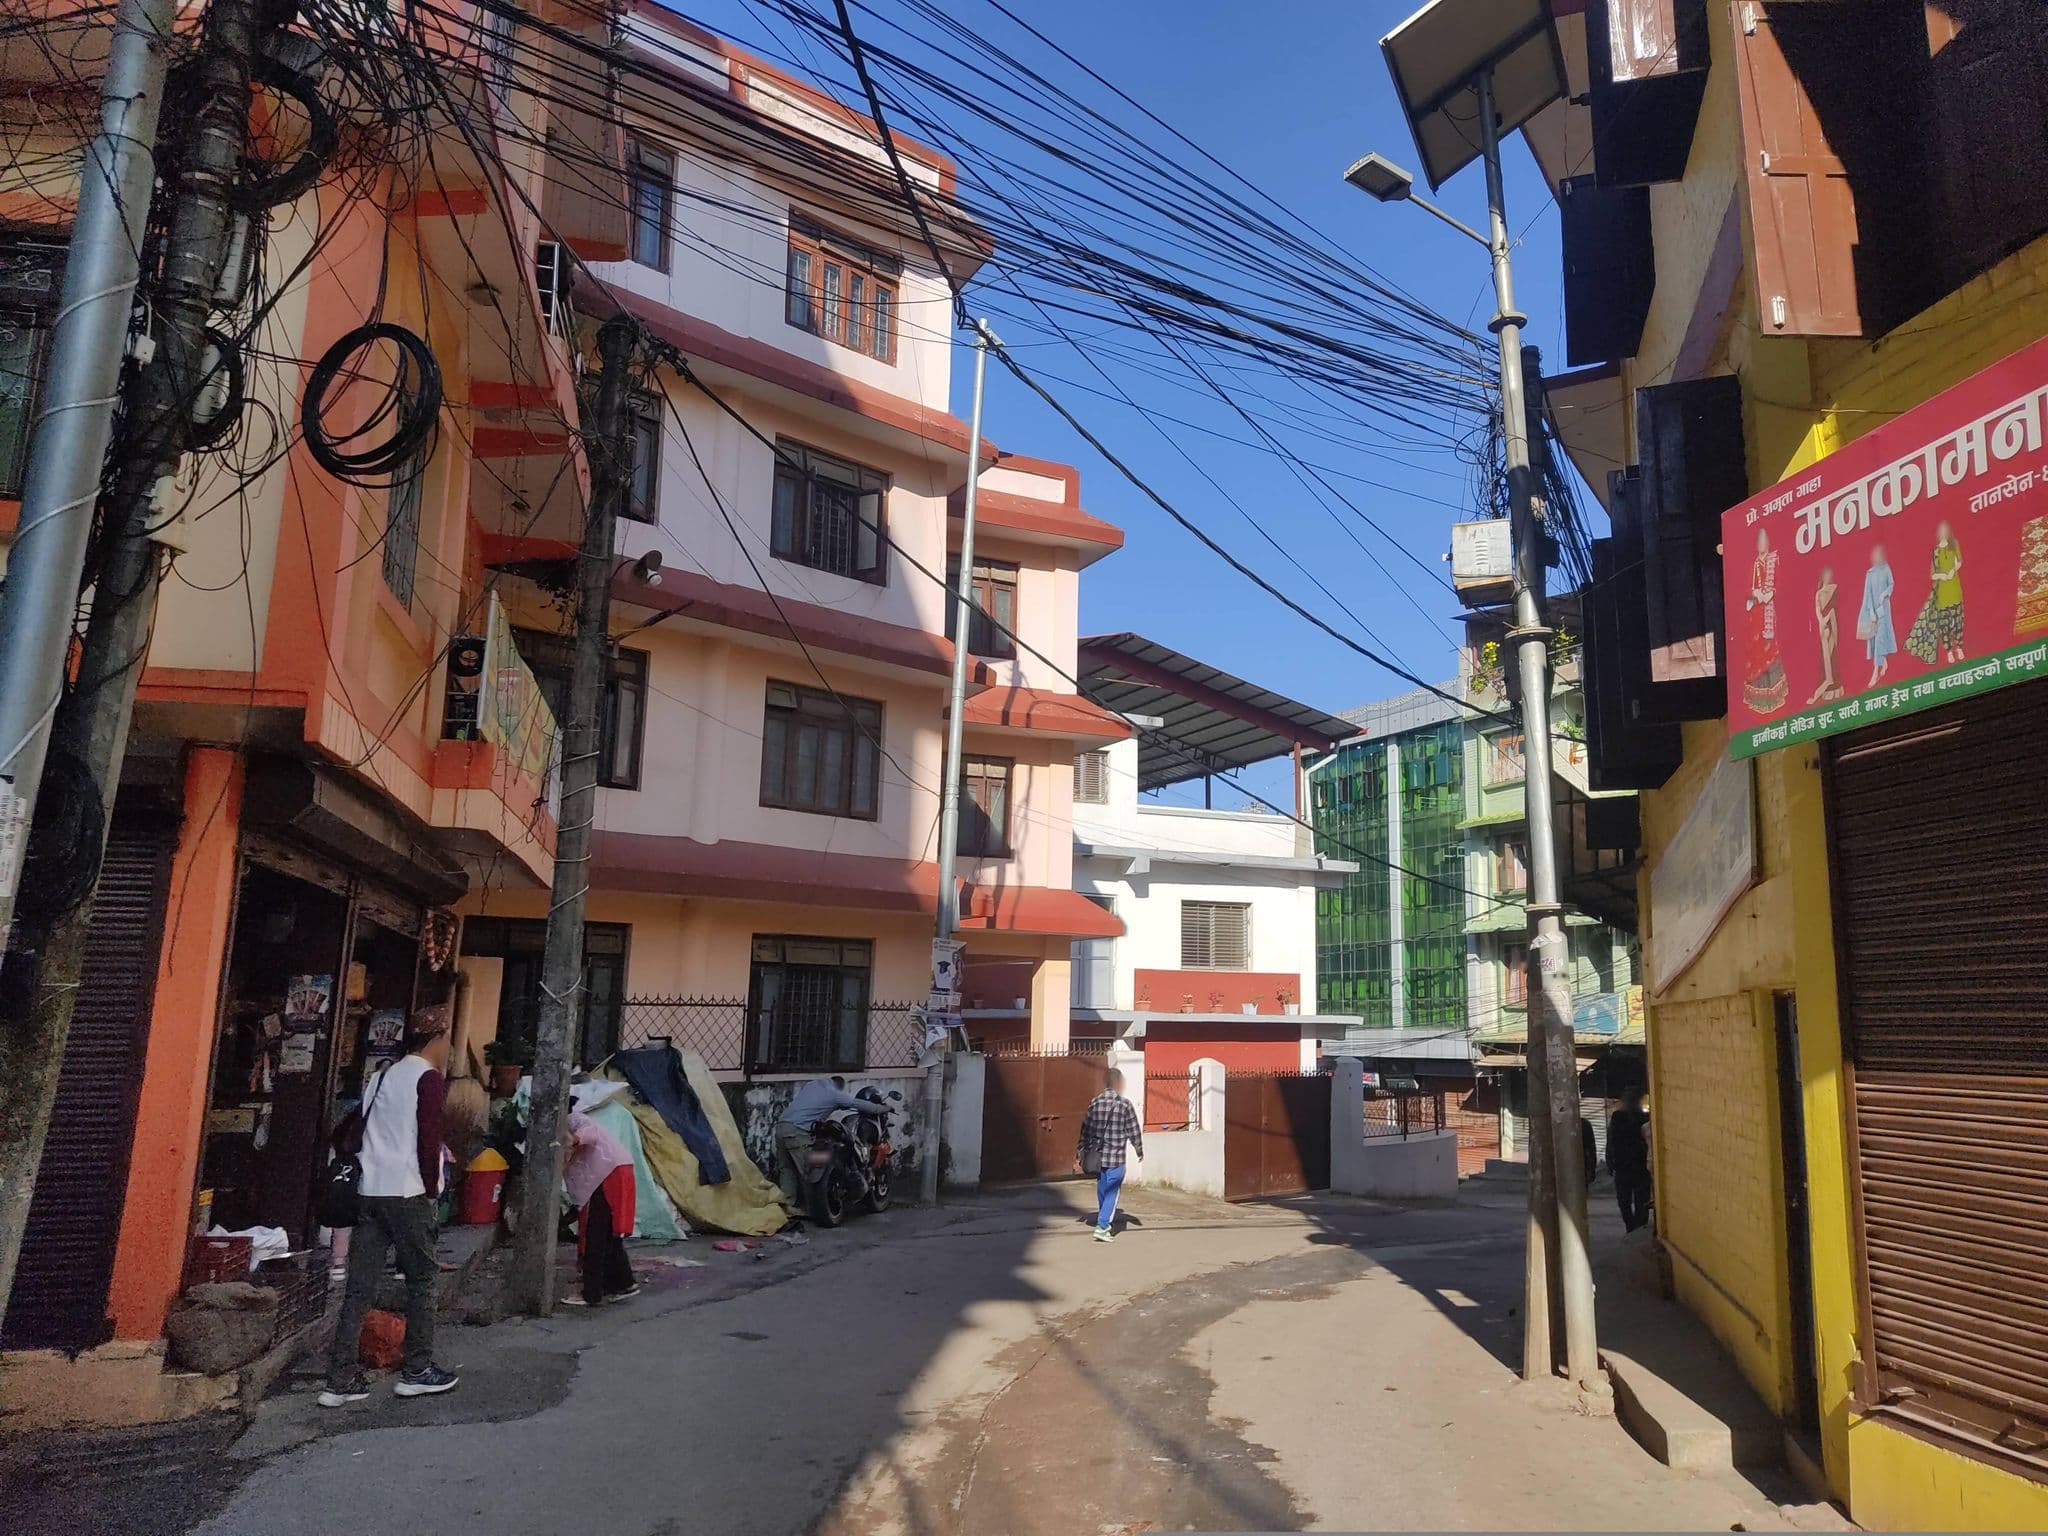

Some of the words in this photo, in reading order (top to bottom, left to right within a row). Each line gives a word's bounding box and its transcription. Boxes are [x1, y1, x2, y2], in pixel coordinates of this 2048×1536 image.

[1745, 508, 1760, 527] प्रो.
[1761, 490, 1793, 516] अमृता
[1794, 383, 2048, 554] मनकामन
[1790, 716, 1815, 735] लेडिज
[1864, 694, 1889, 712] मगर
[1891, 688, 1909, 709] ड्रेस
[1912, 680, 1934, 699] तथा
[2004, 644, 2047, 671] सम्पूर्ण
